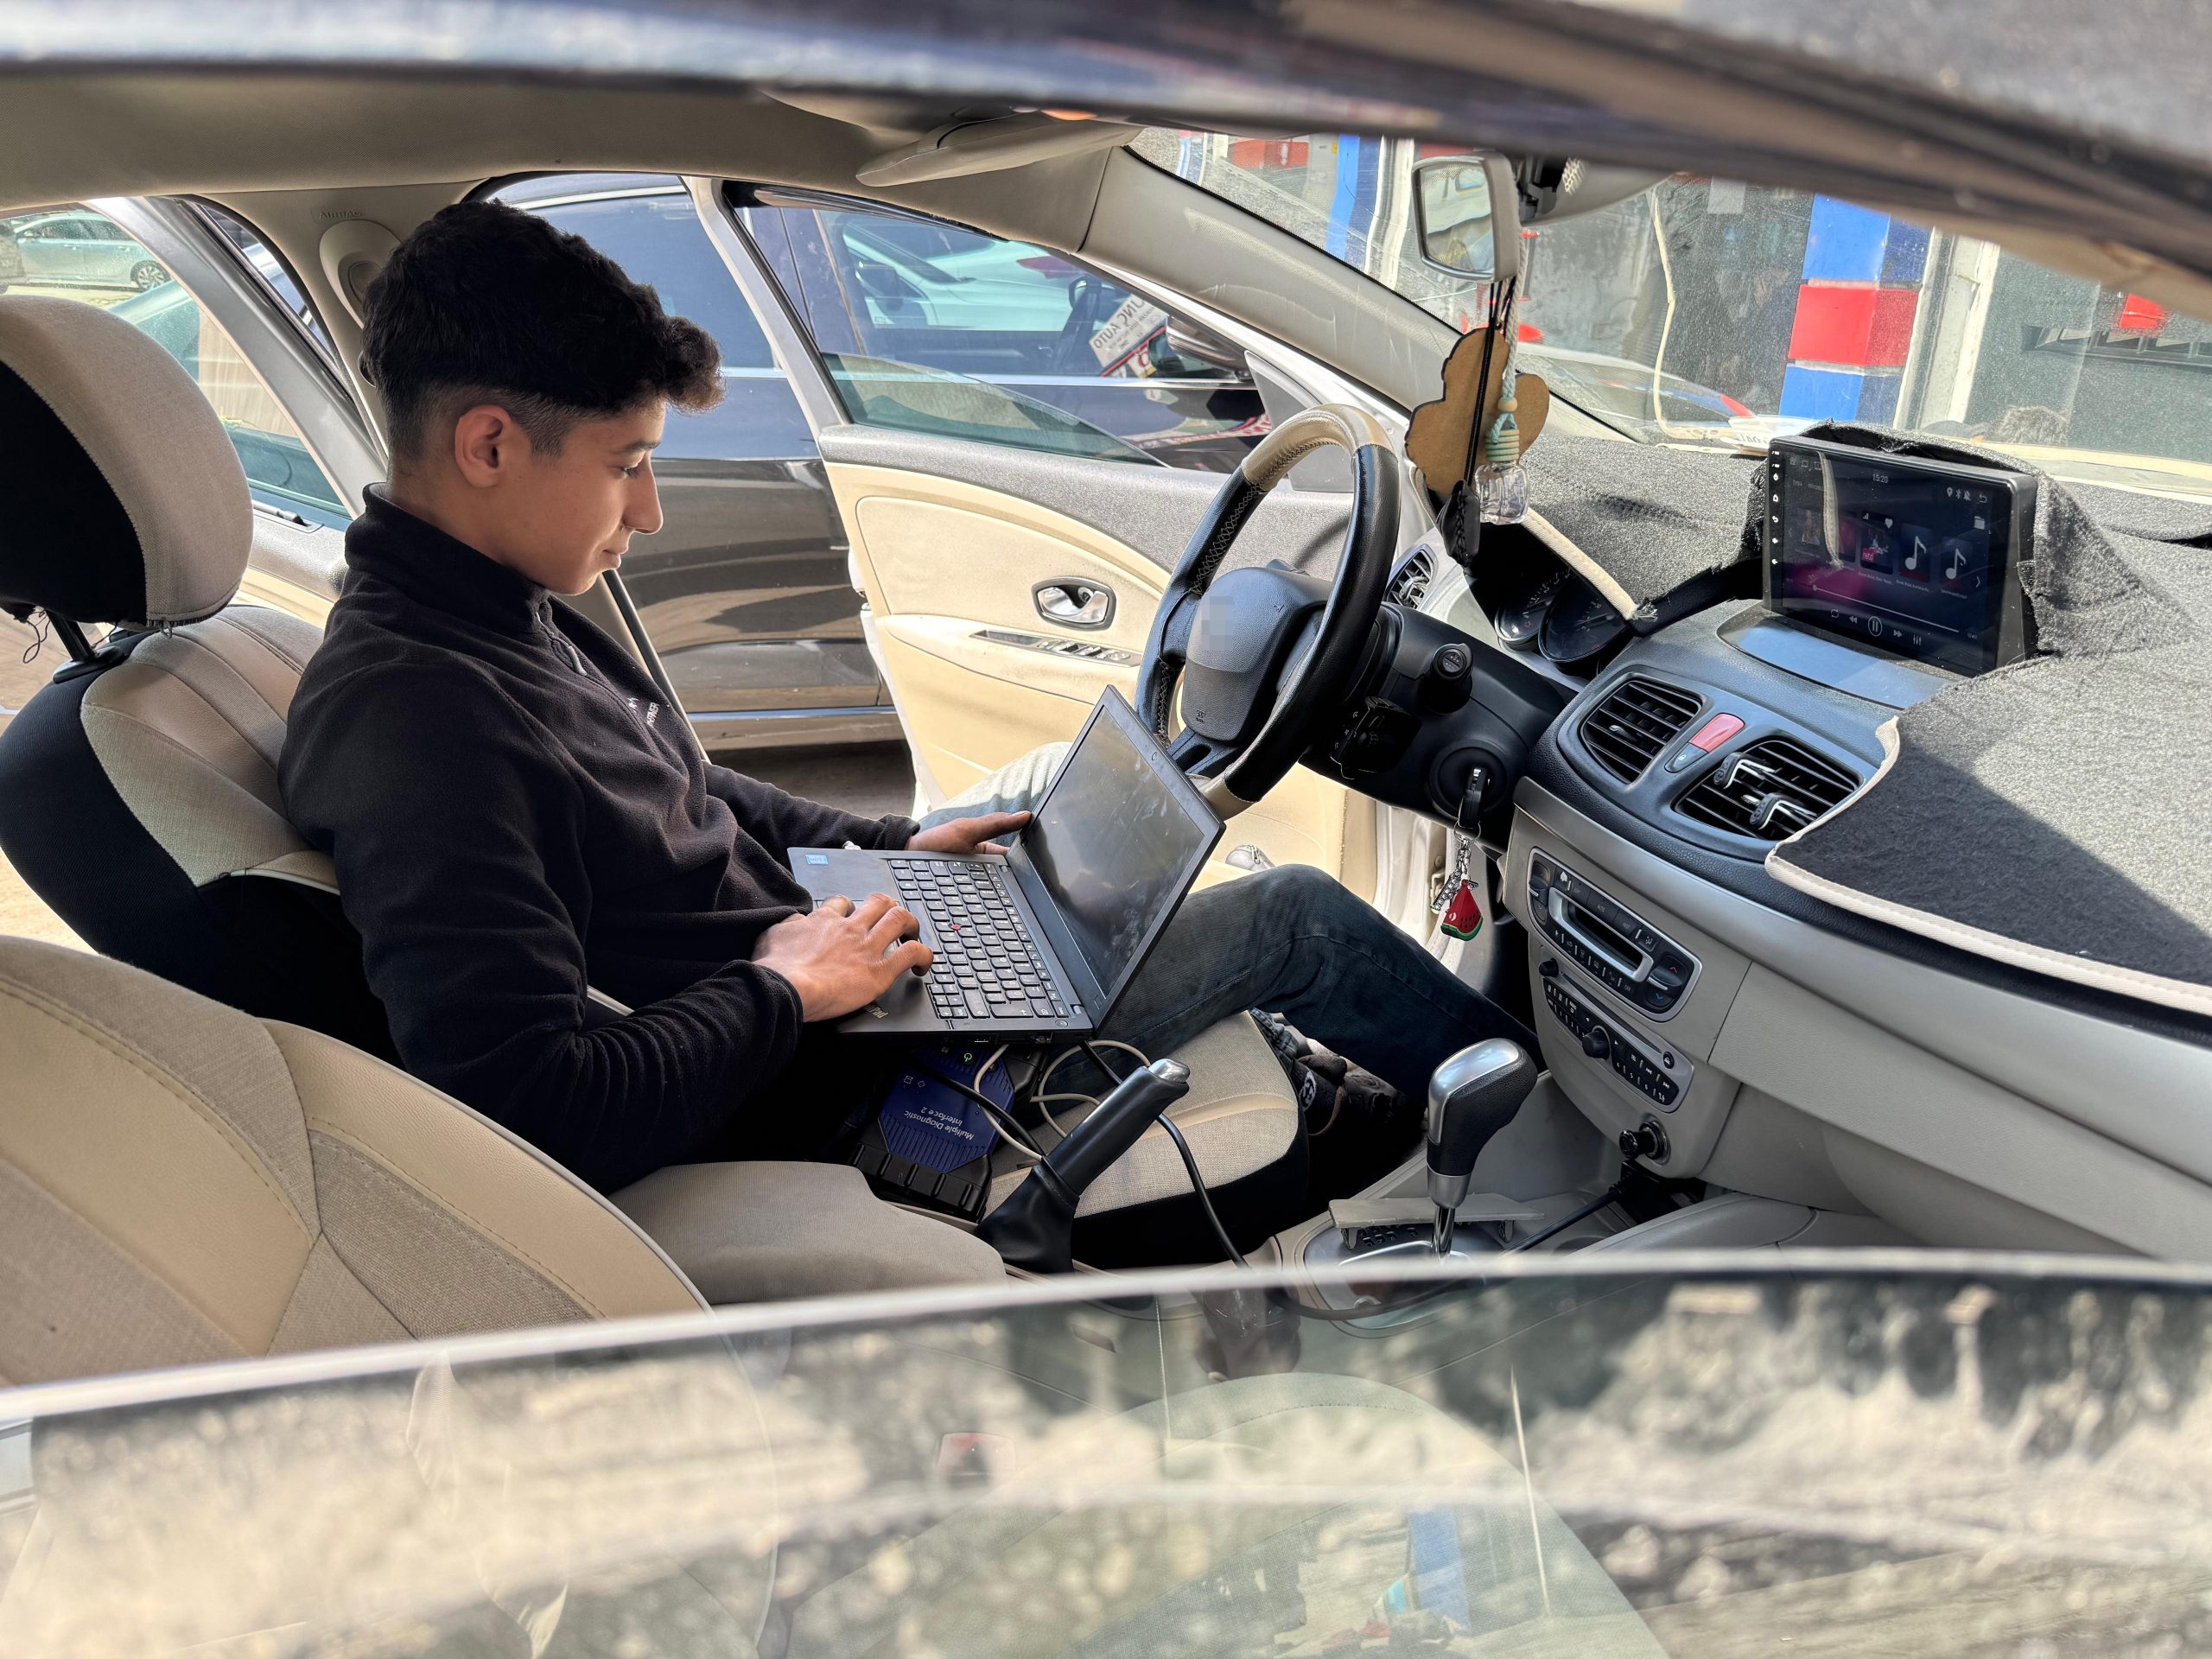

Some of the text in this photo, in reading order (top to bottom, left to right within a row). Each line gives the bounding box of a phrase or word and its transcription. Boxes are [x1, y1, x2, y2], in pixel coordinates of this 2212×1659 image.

[1872, 474, 1888, 484] 15:20
[903, 1110, 975, 1141] Multiple Diagnostic
[928, 1109, 963, 1126] Interface
